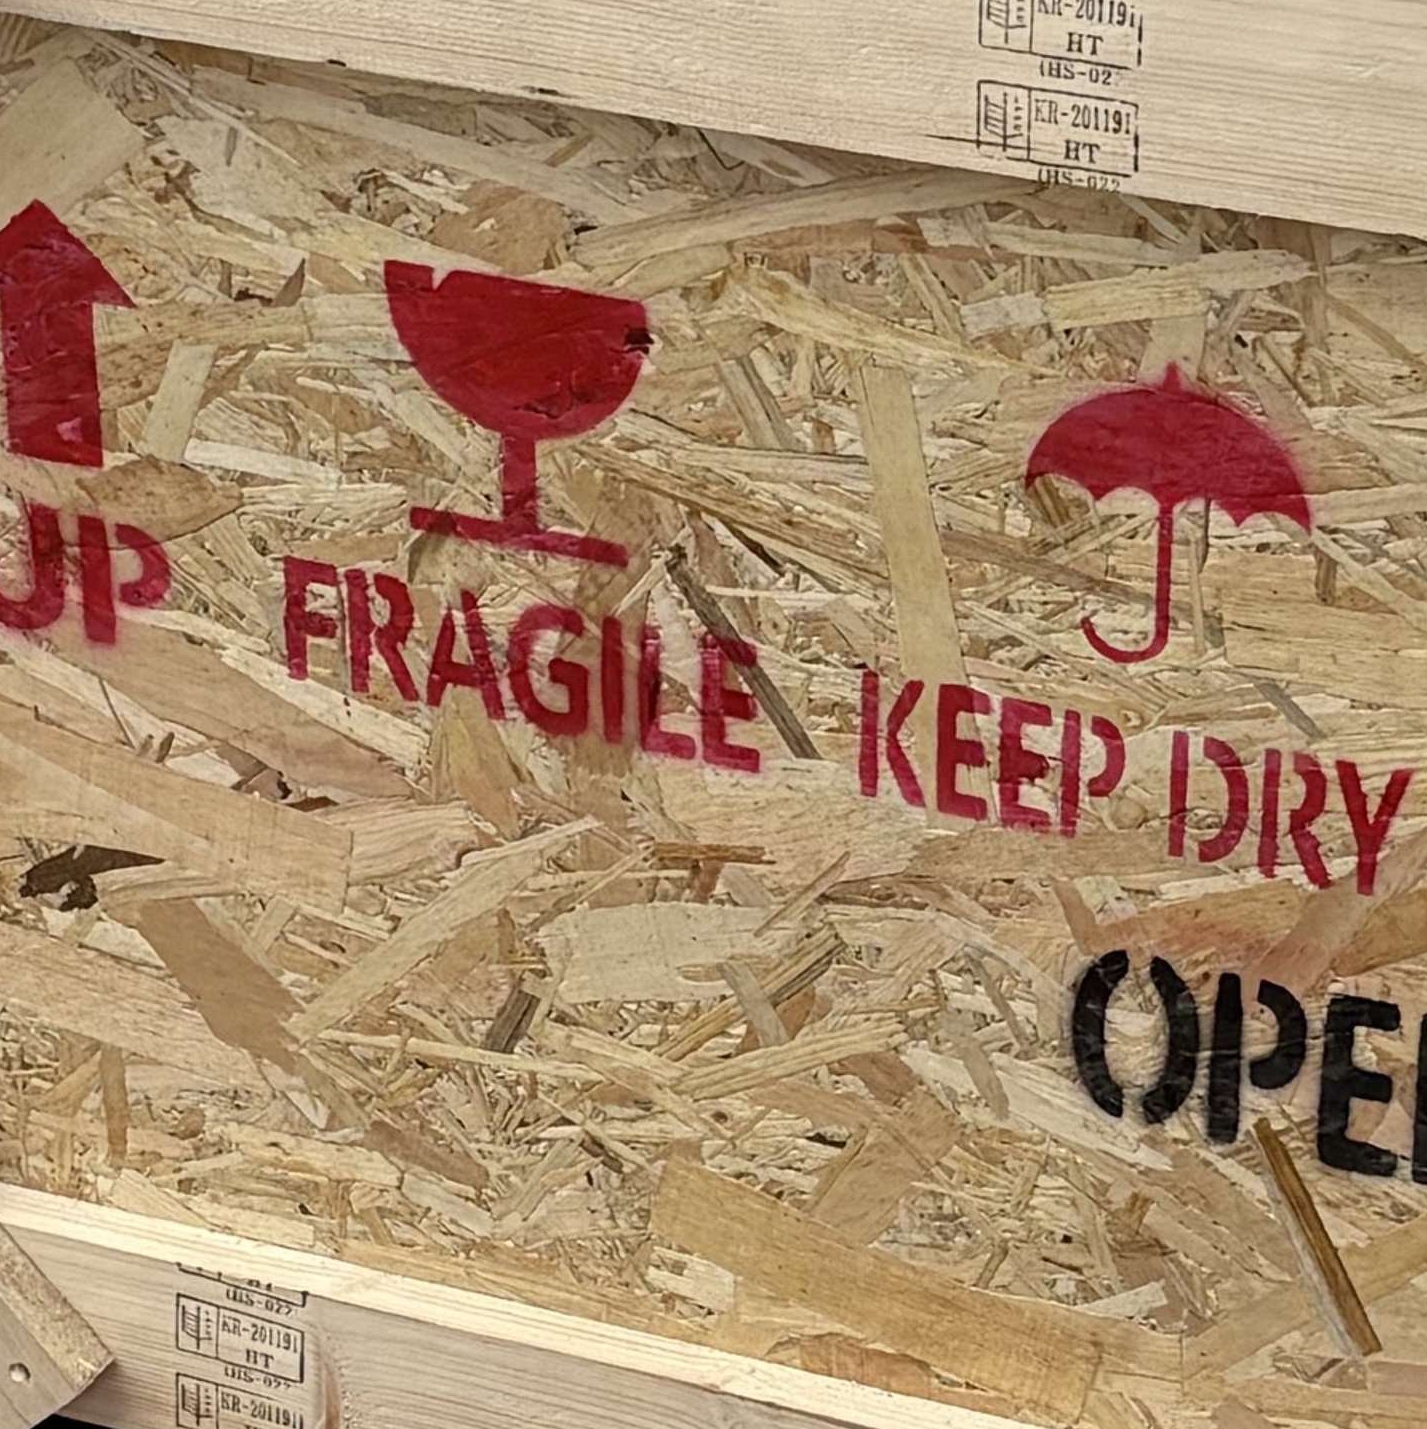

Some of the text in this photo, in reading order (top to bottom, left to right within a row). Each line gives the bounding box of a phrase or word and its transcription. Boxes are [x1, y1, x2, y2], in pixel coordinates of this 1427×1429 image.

[1065, 31, 1105, 56] HT
[1064, 139, 1101, 164] HT
[280, 554, 764, 774] FRAGILE
[859, 666, 1415, 895] KEEP DRY
[245, 1349, 274, 1368] HT
[221, 1391, 298, 1429] KR-201191
